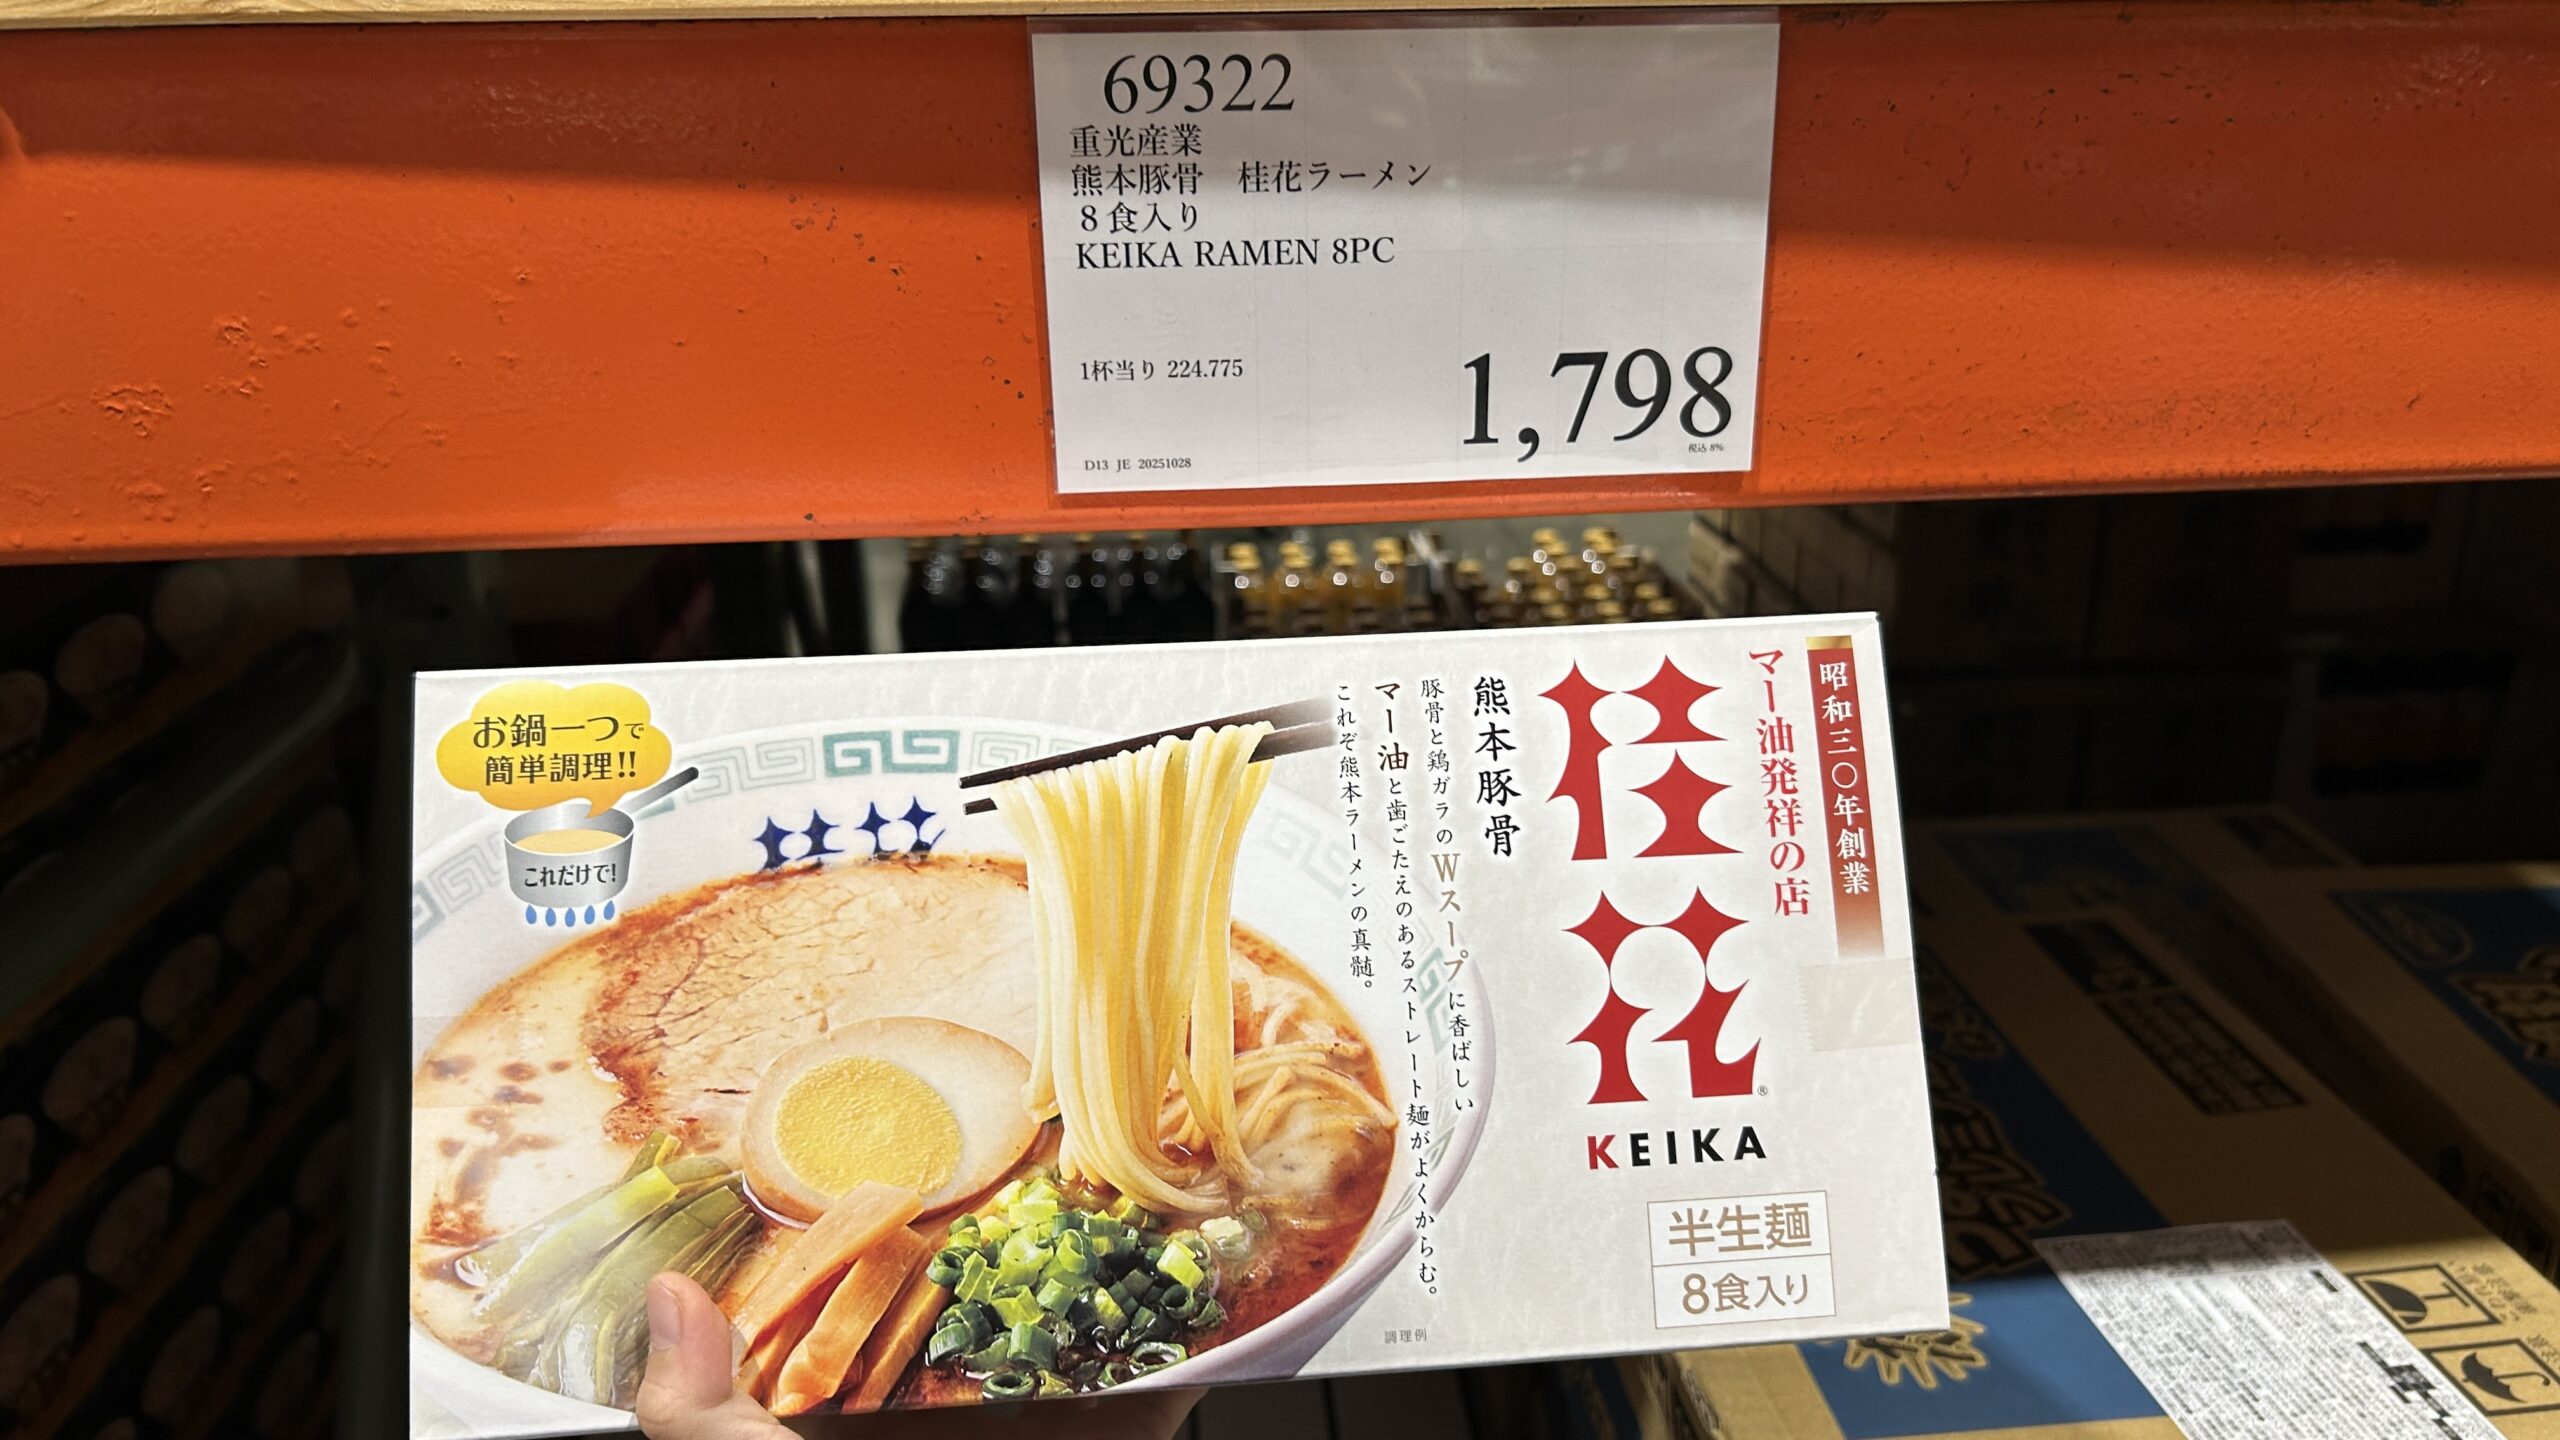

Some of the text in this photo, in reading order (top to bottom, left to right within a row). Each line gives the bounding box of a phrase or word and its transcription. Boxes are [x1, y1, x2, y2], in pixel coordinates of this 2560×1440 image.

[1103, 54, 1295, 115] 69322
[1070, 124, 1203, 157] 重光産業
[1070, 161, 1432, 198] 熊本豚骨 桂花ラーメン
[1081, 202, 1198, 234] 8食入り
[1075, 236, 1396, 270] KEIKA RAMEN 8PC
[1081, 359, 1244, 382] 1杯当り 224.775
[1462, 346, 1734, 463] 1,798
[1084, 457, 1192, 473] D13 JE 20251028
[472, 712, 645, 751] お鍋一つで
[484, 750, 637, 786] 簡単調理!!
[1473, 676, 1523, 859] 熊本豚骨
[1748, 648, 1811, 918] マー油発祥の店
[1818, 661, 1871, 896] 昭和三〇年創業
[1336, 683, 1376, 990] これぞ熊本ラーメンの真髄。
[523, 862, 618, 889] これだけで!
[1420, 678, 1475, 1113] 豚骨と鶏ガラのWスープに香ばしい
[1374, 680, 1438, 1297] マー油と歯ごたえのあるストレート麺がよくからむ。
[1587, 1126, 1767, 1171] KEIKA
[1668, 1201, 1813, 1257] 半生麺
[1681, 1272, 1811, 1316] 8食入り
[1384, 1327, 1428, 1345] 調理例
